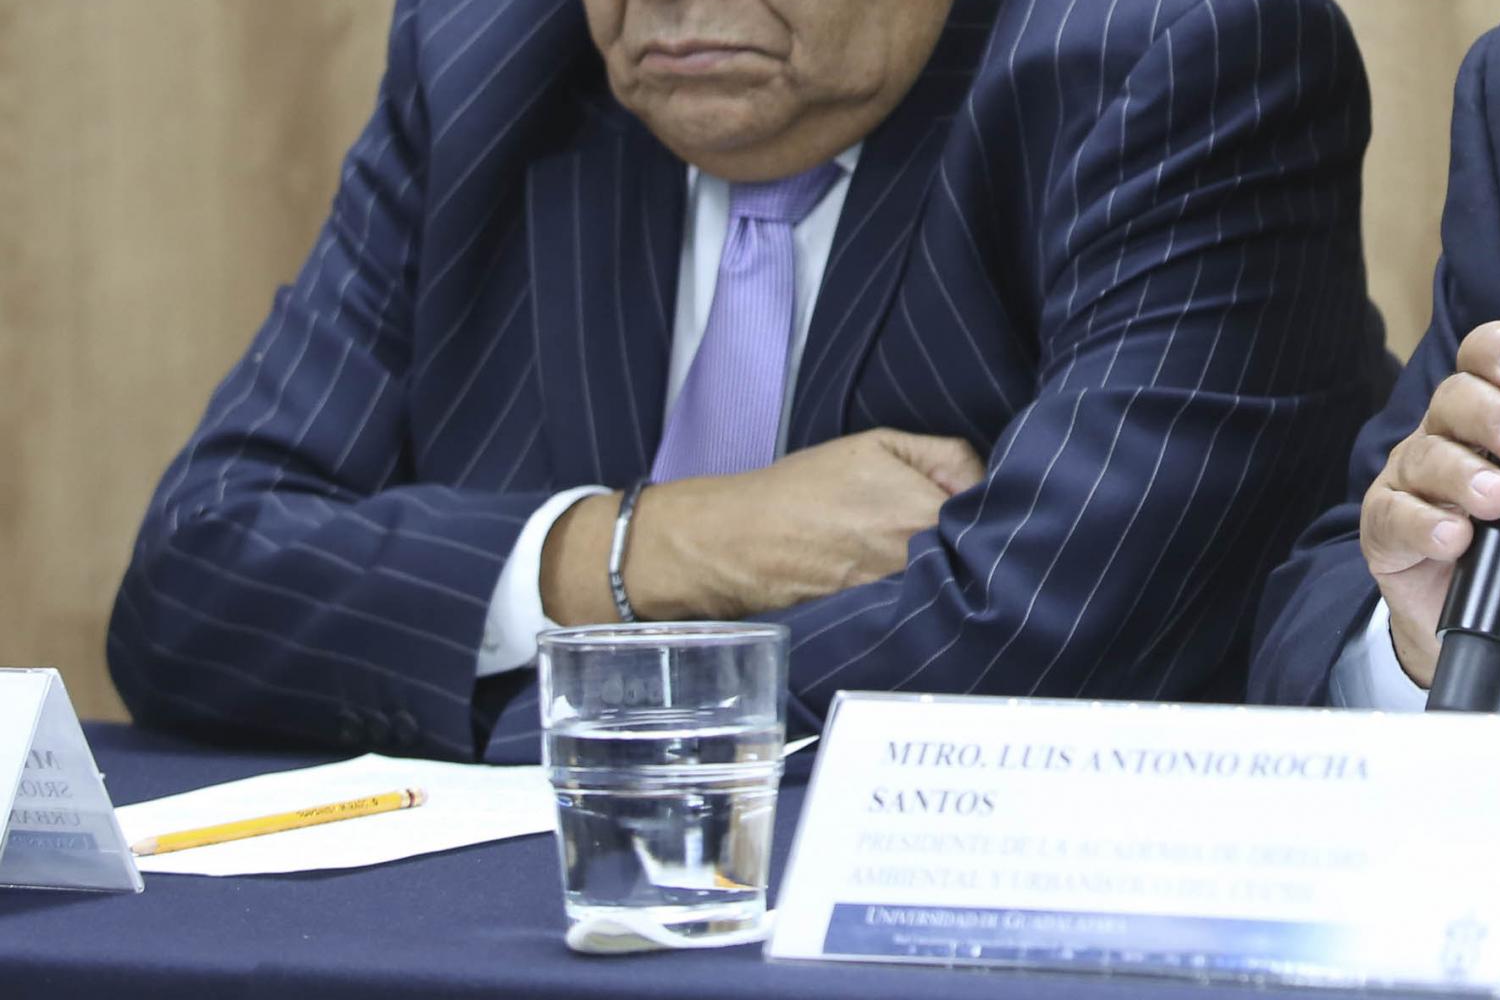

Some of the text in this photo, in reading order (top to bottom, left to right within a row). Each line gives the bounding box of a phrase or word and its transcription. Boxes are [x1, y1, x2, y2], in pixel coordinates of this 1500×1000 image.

[881, 739, 1370, 781] MTRO. LUIS ANTONIO ROCHA
[867, 786, 998, 817] SANTOS
